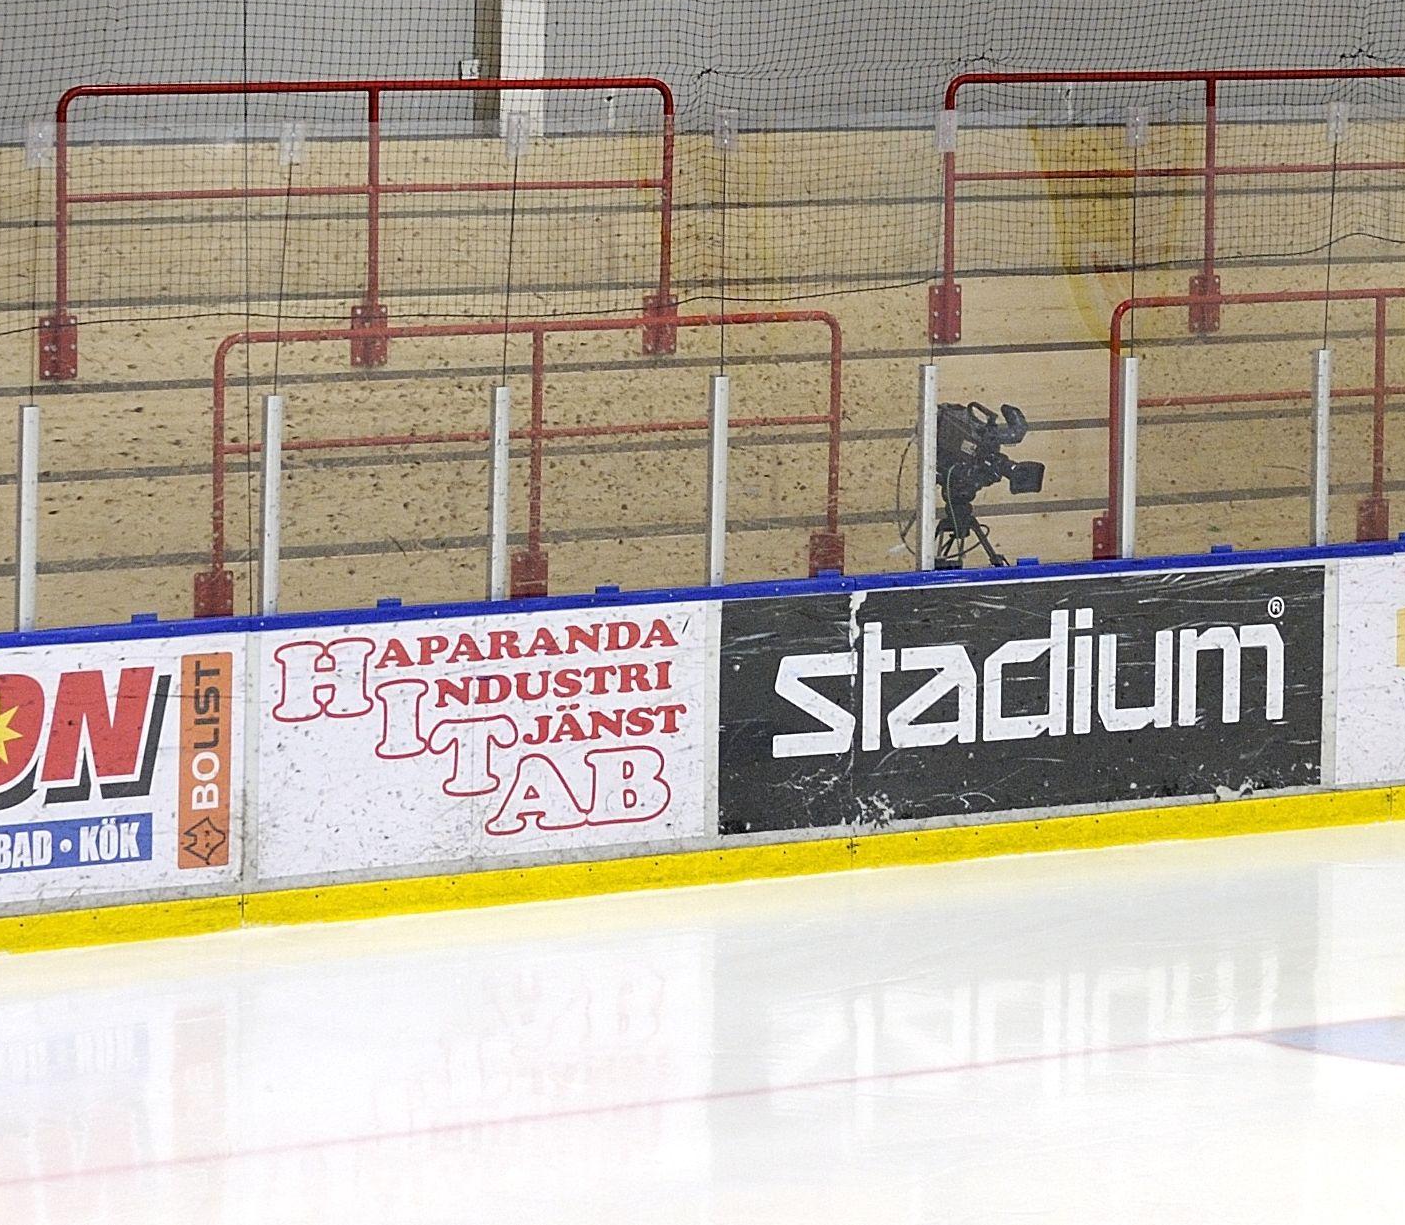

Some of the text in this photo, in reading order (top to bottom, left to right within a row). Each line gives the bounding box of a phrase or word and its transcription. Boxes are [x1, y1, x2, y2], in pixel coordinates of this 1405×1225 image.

[191, 660, 221, 811] BOLIST
[772, 607, 1284, 759] stadium
[79, 819, 141, 862] KÖK
